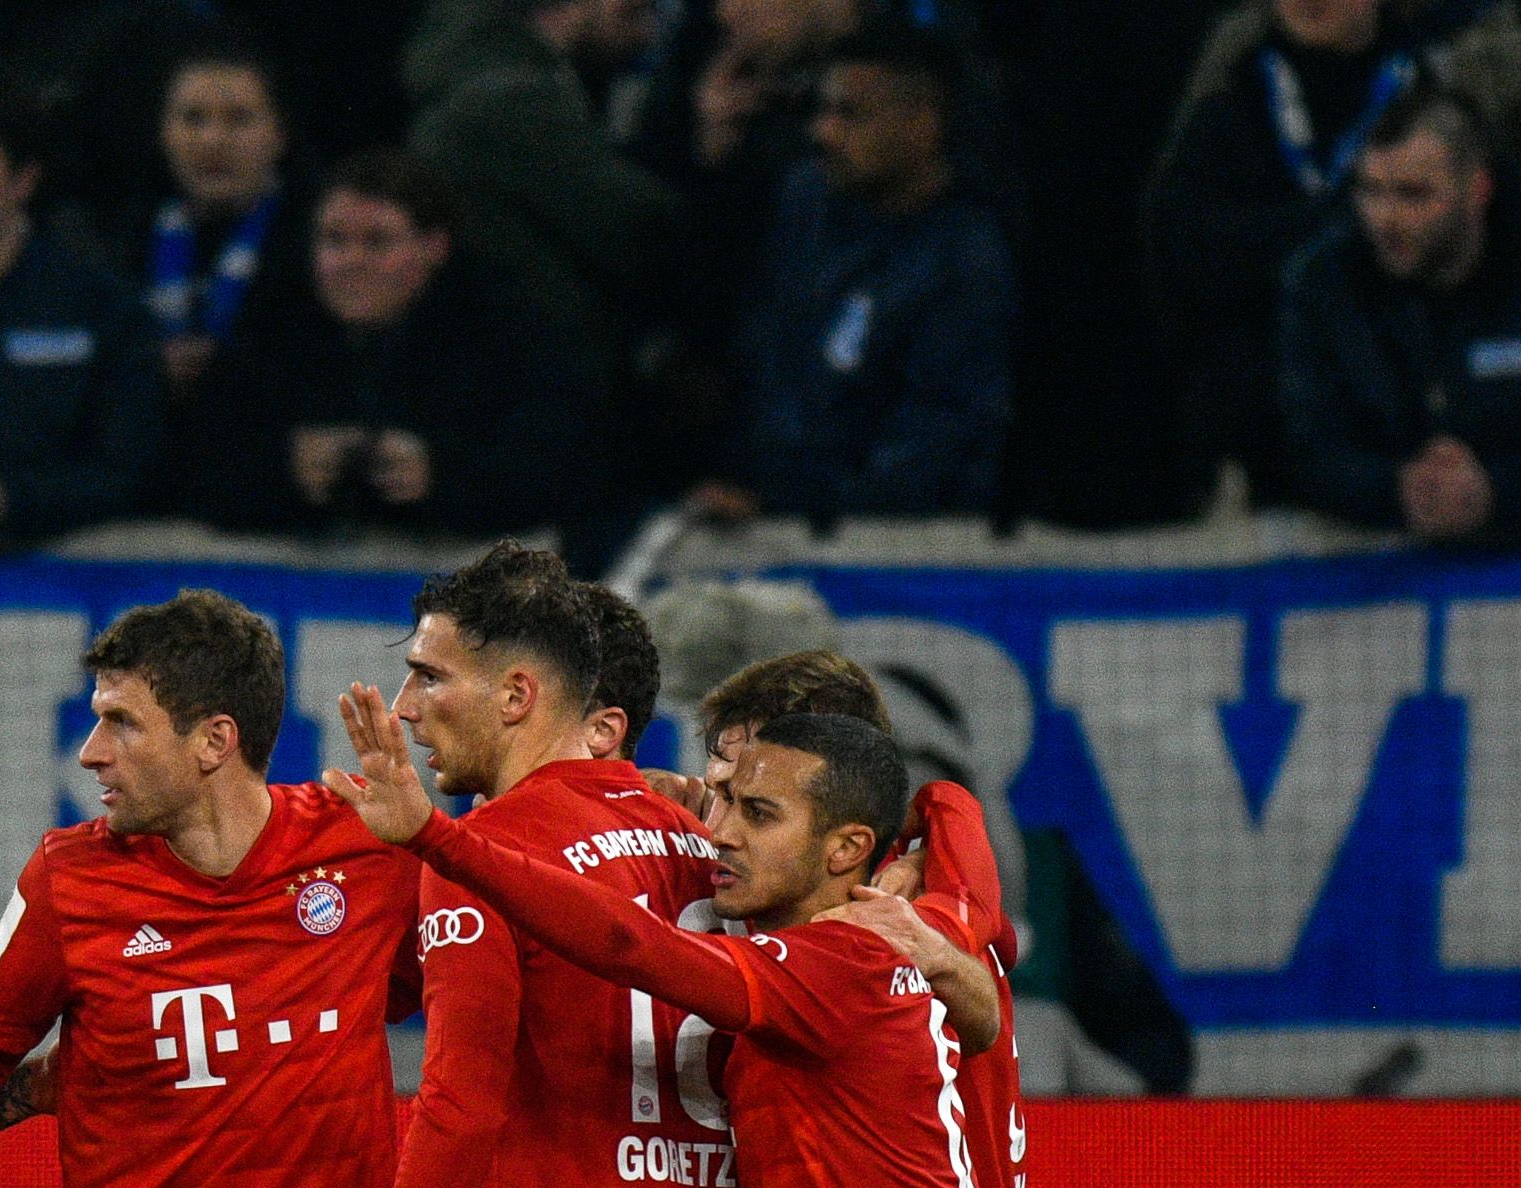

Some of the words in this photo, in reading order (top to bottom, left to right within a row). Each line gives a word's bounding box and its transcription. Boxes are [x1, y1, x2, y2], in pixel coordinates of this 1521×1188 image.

[563, 841, 599, 874] FC
[590, 828, 669, 861] BAYERN
[306, 885, 340, 902] BAYERN
[122, 940, 172, 957] adidas
[617, 1134, 737, 1188] GORETZ
